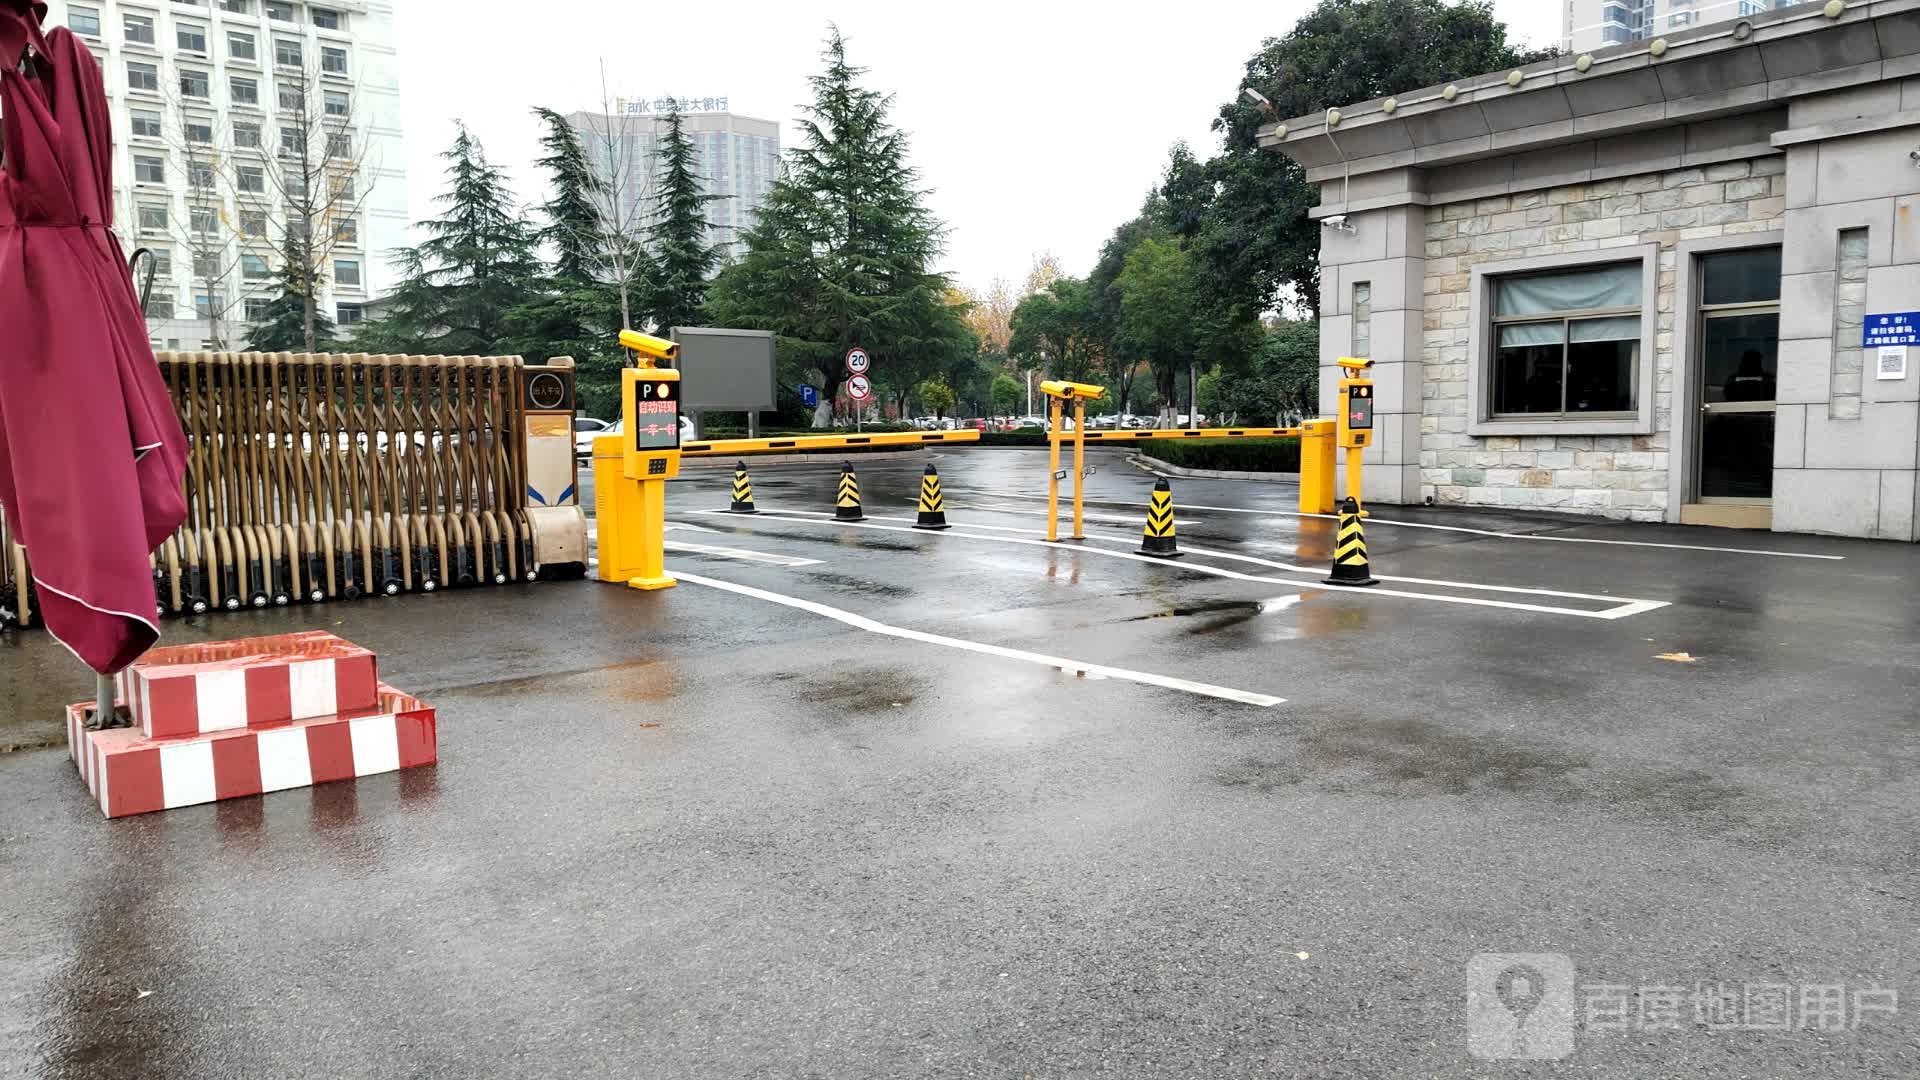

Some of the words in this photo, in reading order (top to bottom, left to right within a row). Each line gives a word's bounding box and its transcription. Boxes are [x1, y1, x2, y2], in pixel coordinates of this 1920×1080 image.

[852, 355, 864, 366] 20
[643, 383, 652, 398] P
[803, 387, 812, 400] P
